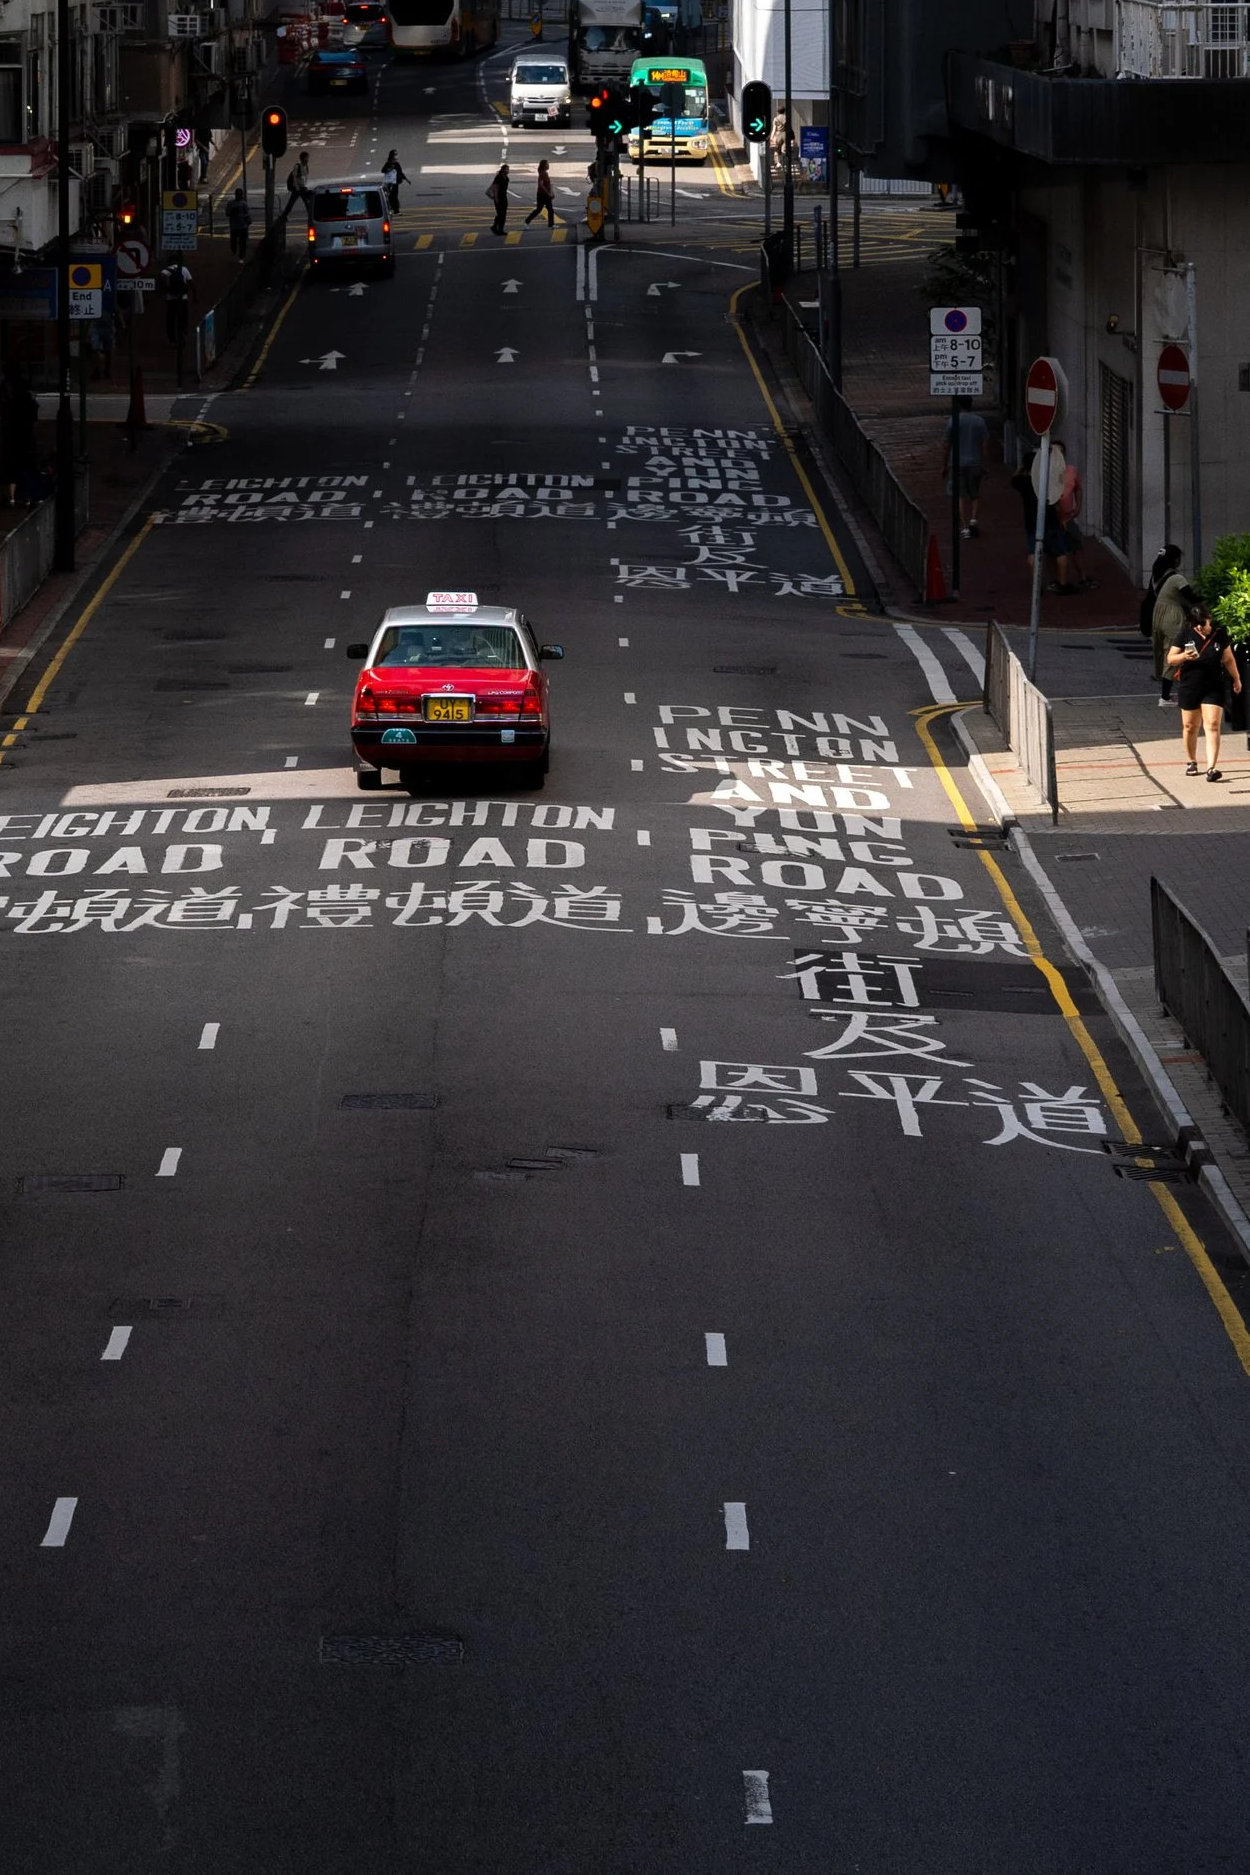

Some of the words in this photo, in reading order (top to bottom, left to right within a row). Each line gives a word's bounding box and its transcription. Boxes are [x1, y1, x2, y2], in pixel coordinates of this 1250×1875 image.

[176, 212, 196, 220] 8-10
[73, 292, 92, 301] End
[69, 303, 95, 315] 終止
[950, 339, 981, 350] 8-10
[950, 356, 975, 368] 5-7
[621, 436, 770, 450] INGTON
[626, 425, 758, 440] PENN
[614, 444, 773, 461] STREET
[644, 455, 758, 468] AND
[627, 476, 763, 491] PING
[644, 466, 760, 481] YUN
[182, 490, 348, 506] ROAD
[411, 487, 573, 502] ROAD
[627, 489, 791, 506] ROAD
[147, 502, 367, 526] 禮頓道
[677, 525, 758, 546] 街
[684, 545, 769, 569] 及
[614, 564, 859, 601] 恩平道
[433, 593, 473, 603] TAXI
[433, 709, 464, 721] 9415
[439, 699, 456, 710] UY
[657, 705, 890, 737] PENN
[652, 726, 900, 763] INGTON
[657, 752, 917, 789] STREET
[710, 778, 890, 810] AND
[300, 800, 615, 831] LEIGHTON
[710, 803, 902, 841] YUN
[317, 836, 586, 870] ROAD
[690, 827, 914, 866] PING
[690, 854, 965, 901] ROAD
[251, 880, 634, 934] 禮頓道
[662, 888, 1035, 957] 邊寧頓
[775, 951, 923, 1007] 街
[801, 1008, 975, 1067] 及
[686, 1060, 1110, 1154] 恩平道
